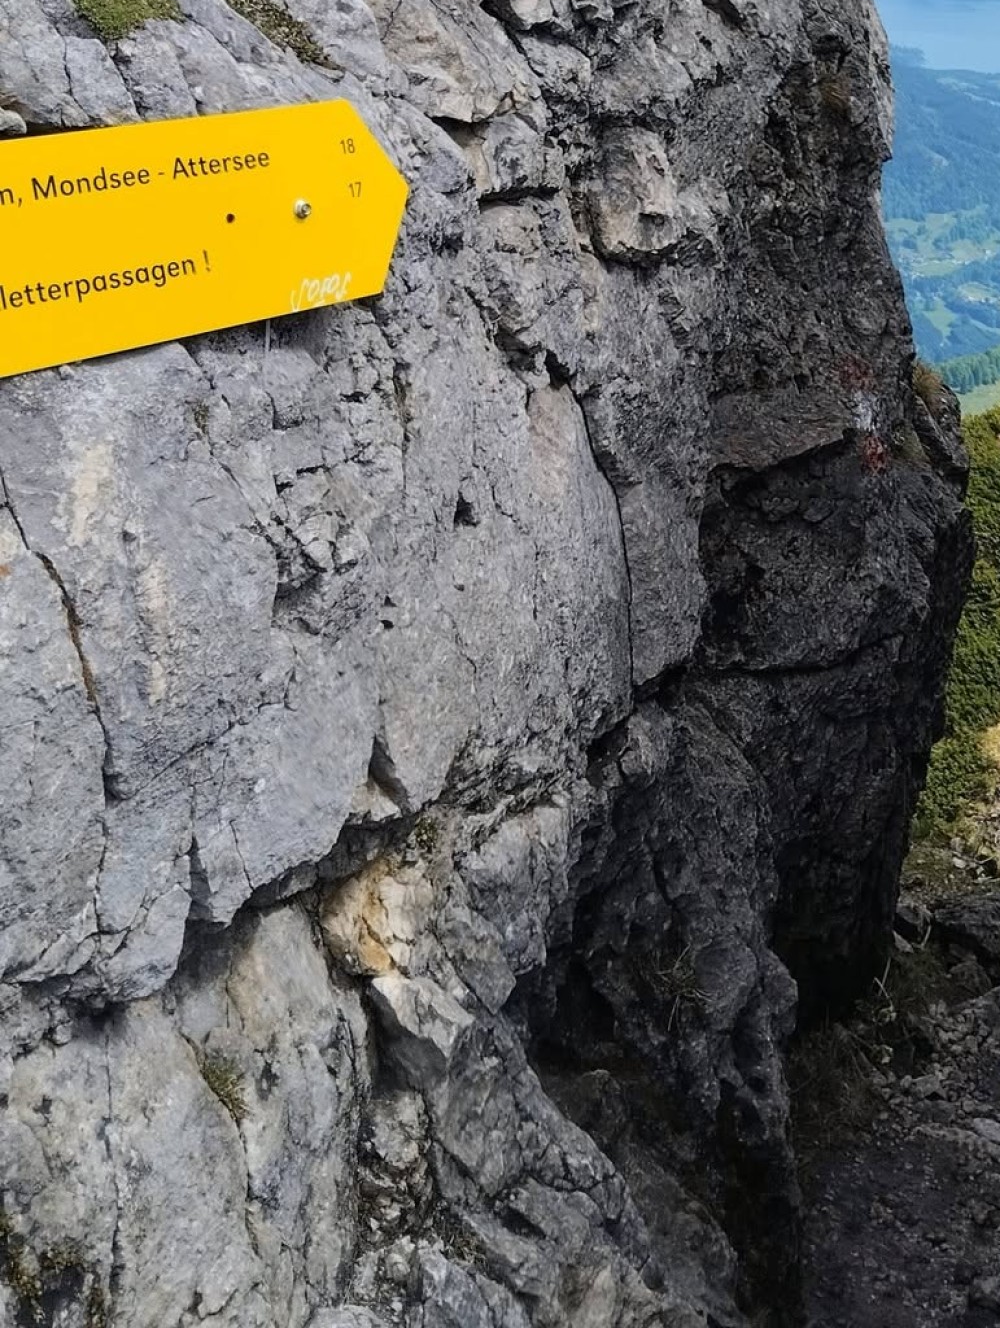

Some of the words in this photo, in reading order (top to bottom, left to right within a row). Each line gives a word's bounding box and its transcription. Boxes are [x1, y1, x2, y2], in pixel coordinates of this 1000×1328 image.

[340, 138, 355, 154] 18
[31, 166, 150, 200] Mondsee
[173, 152, 270, 180] Attersee
[349, 181, 361, 198] 17
